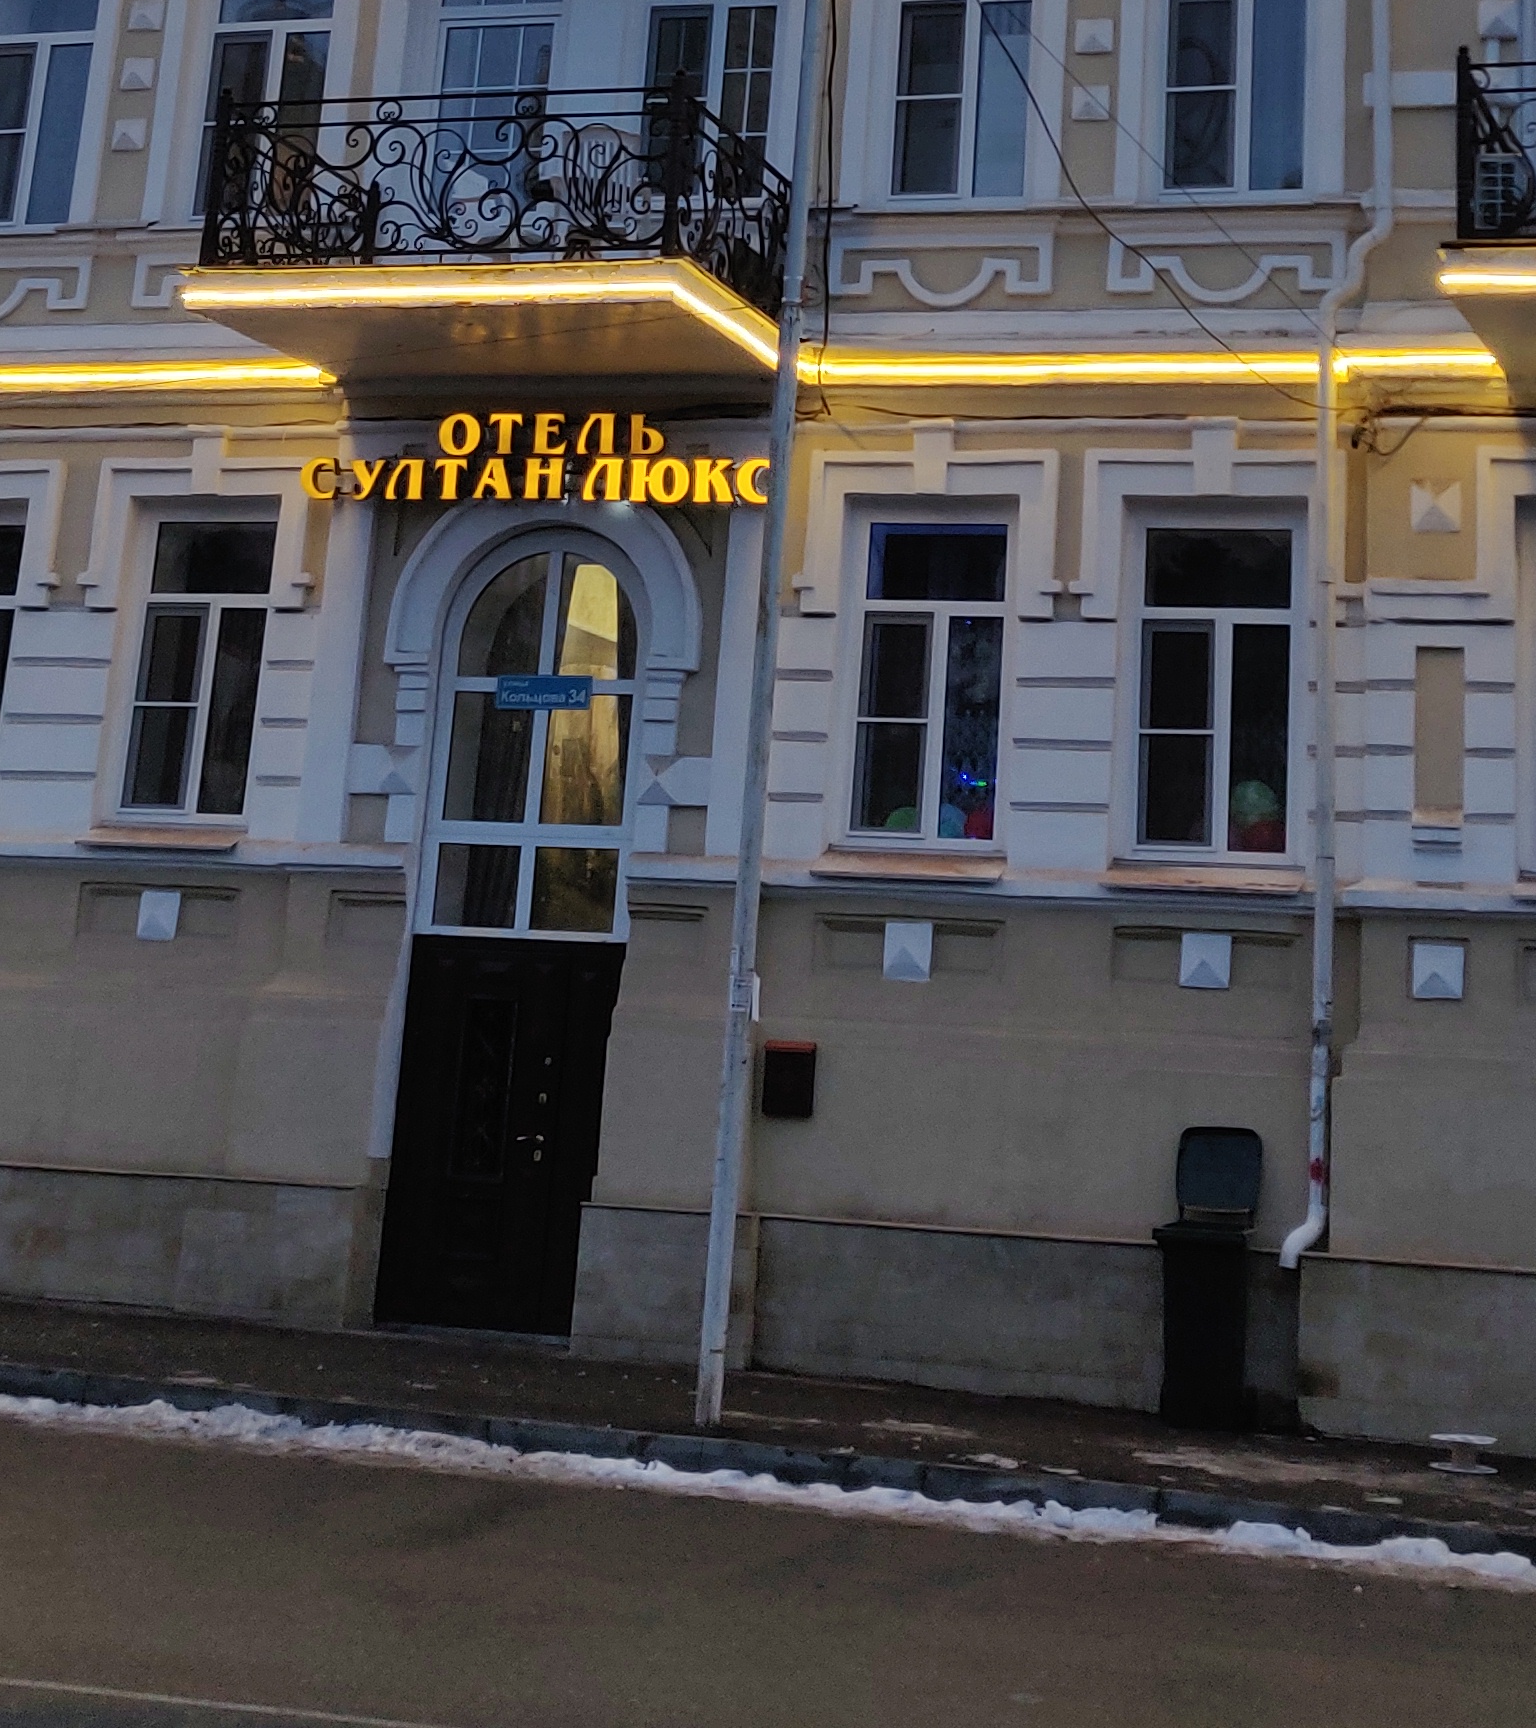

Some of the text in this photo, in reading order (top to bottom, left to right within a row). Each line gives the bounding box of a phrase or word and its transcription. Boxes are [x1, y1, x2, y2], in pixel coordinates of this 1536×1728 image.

[438, 412, 665, 455] ОТЕЛЬ
[300, 457, 770, 504] СУЛТАН ЛЮКС
[568, 689, 586, 703] 34
